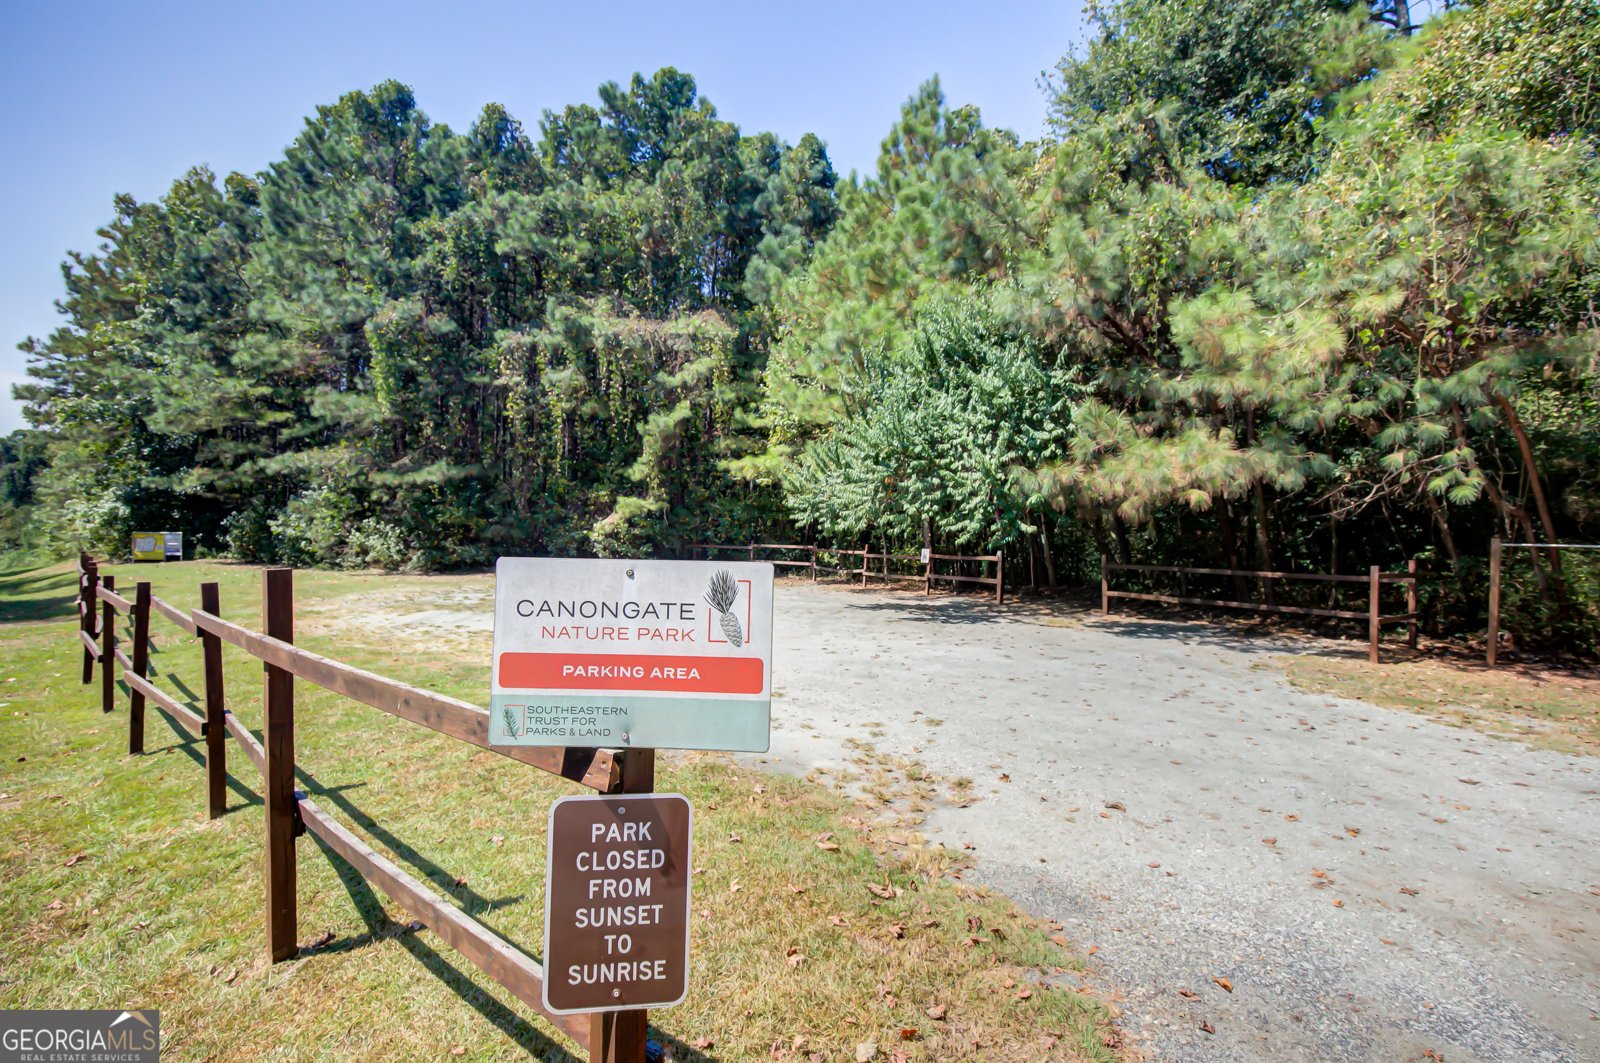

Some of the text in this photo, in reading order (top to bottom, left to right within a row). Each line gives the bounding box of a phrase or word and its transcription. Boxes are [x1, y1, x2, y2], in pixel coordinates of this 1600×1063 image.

[516, 599, 696, 620] CANONGATE
[541, 625, 695, 642] NATURE PARK
[562, 665, 701, 680] PARKING AREA
[527, 705, 628, 716] SOUTHEASTERN
[527, 716, 597, 726] TRUST FOR
[525, 727, 611, 737] PARKS & LAND
[591, 821, 652, 843] PARK
[575, 848, 665, 872] CLOSED
[588, 877, 651, 899] FROM
[575, 904, 664, 928] SUNSET
[604, 934, 632, 955] TO
[568, 960, 667, 985] SUNRISE
